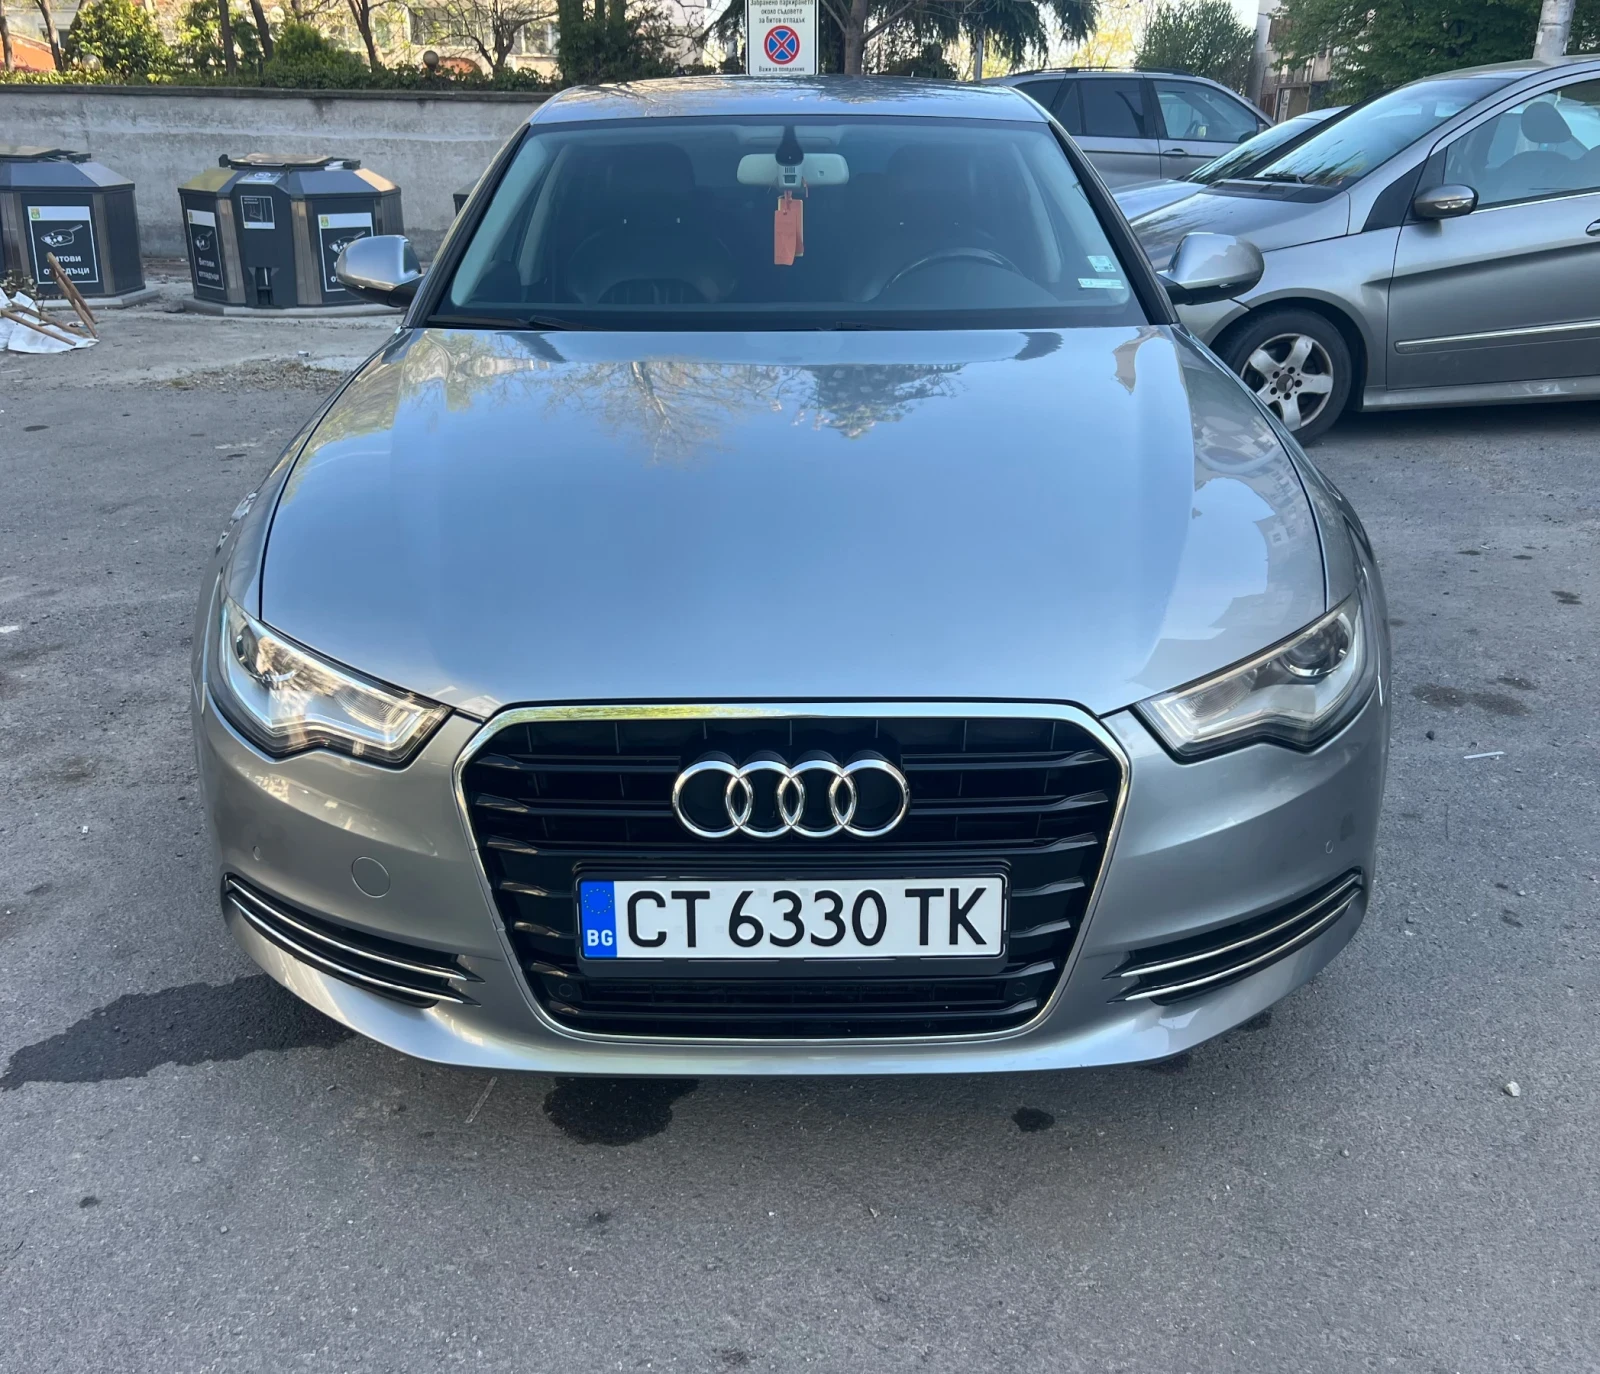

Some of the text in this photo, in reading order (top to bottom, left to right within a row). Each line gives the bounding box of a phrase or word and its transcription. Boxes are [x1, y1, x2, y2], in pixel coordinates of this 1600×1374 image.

[627, 887, 988, 948] CT 6330 TK
[587, 930, 613, 946] BG
